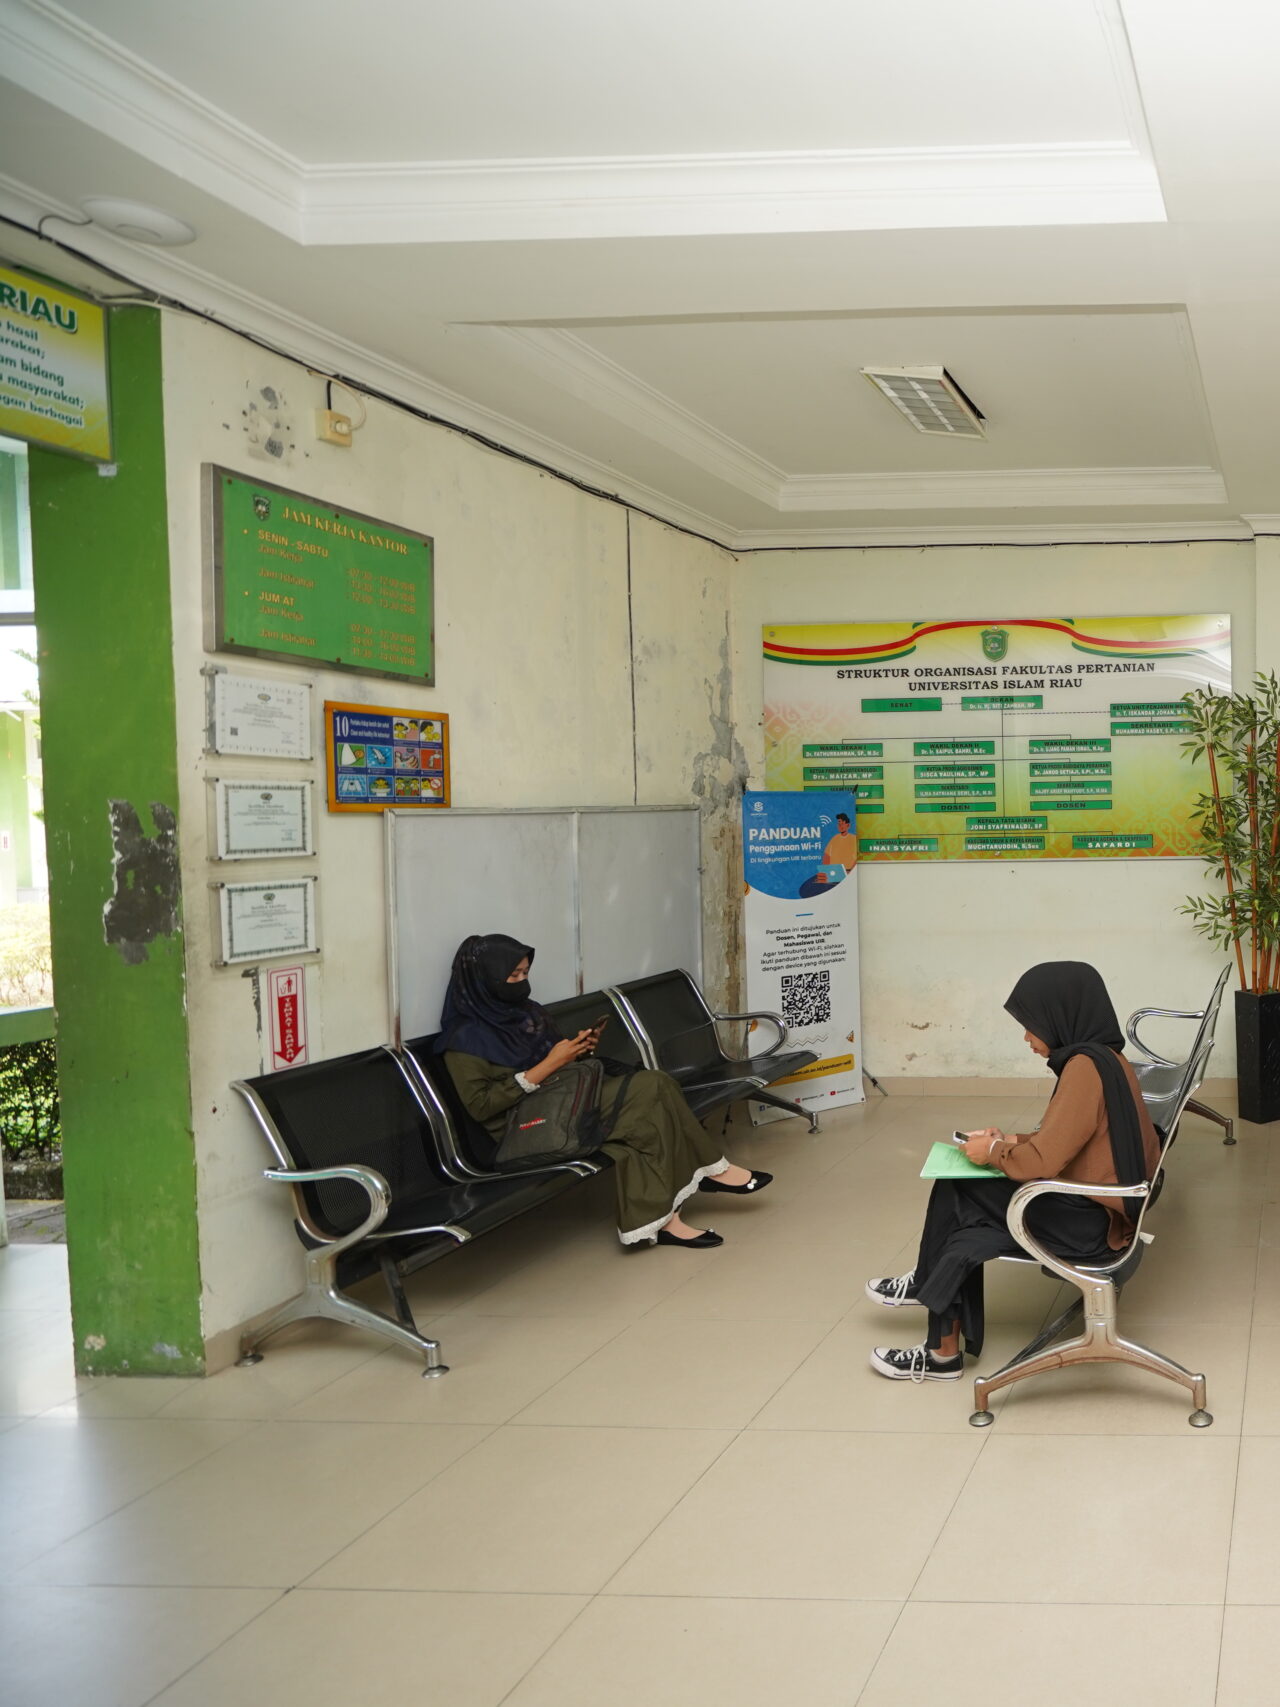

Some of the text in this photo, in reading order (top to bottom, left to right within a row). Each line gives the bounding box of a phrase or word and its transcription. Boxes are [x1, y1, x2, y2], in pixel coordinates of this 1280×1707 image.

[0, 282, 77, 331] RIAU
[7, 320, 38, 341] hasil
[21, 358, 64, 387] bidang
[8, 375, 84, 409] masyarakat;
[30, 401, 83, 427] berbagai
[282, 506, 408, 555] JAM KERJA KANTOR
[258, 529, 288, 546] SENIN
[296, 540, 329, 558] SABTU
[836, 662, 1156, 679] STRUKTUR ORGANISASI FAKULTAS PERTANIAN
[908, 678, 1083, 691] UNIVERSITAS ISLAM RIAU
[335, 715, 349, 737] 10
[749, 826, 821, 841] PANDUAN
[749, 842, 821, 855] Penggunaan Wi-Fi
[757, 856, 790, 864] lingkungan
[777, 947, 807, 955] terhubung
[783, 939, 814, 948] Mahasiswa
[761, 964, 785, 972] dengan
[803, 960, 818, 968] yang
[774, 955, 800, 964] panduan
